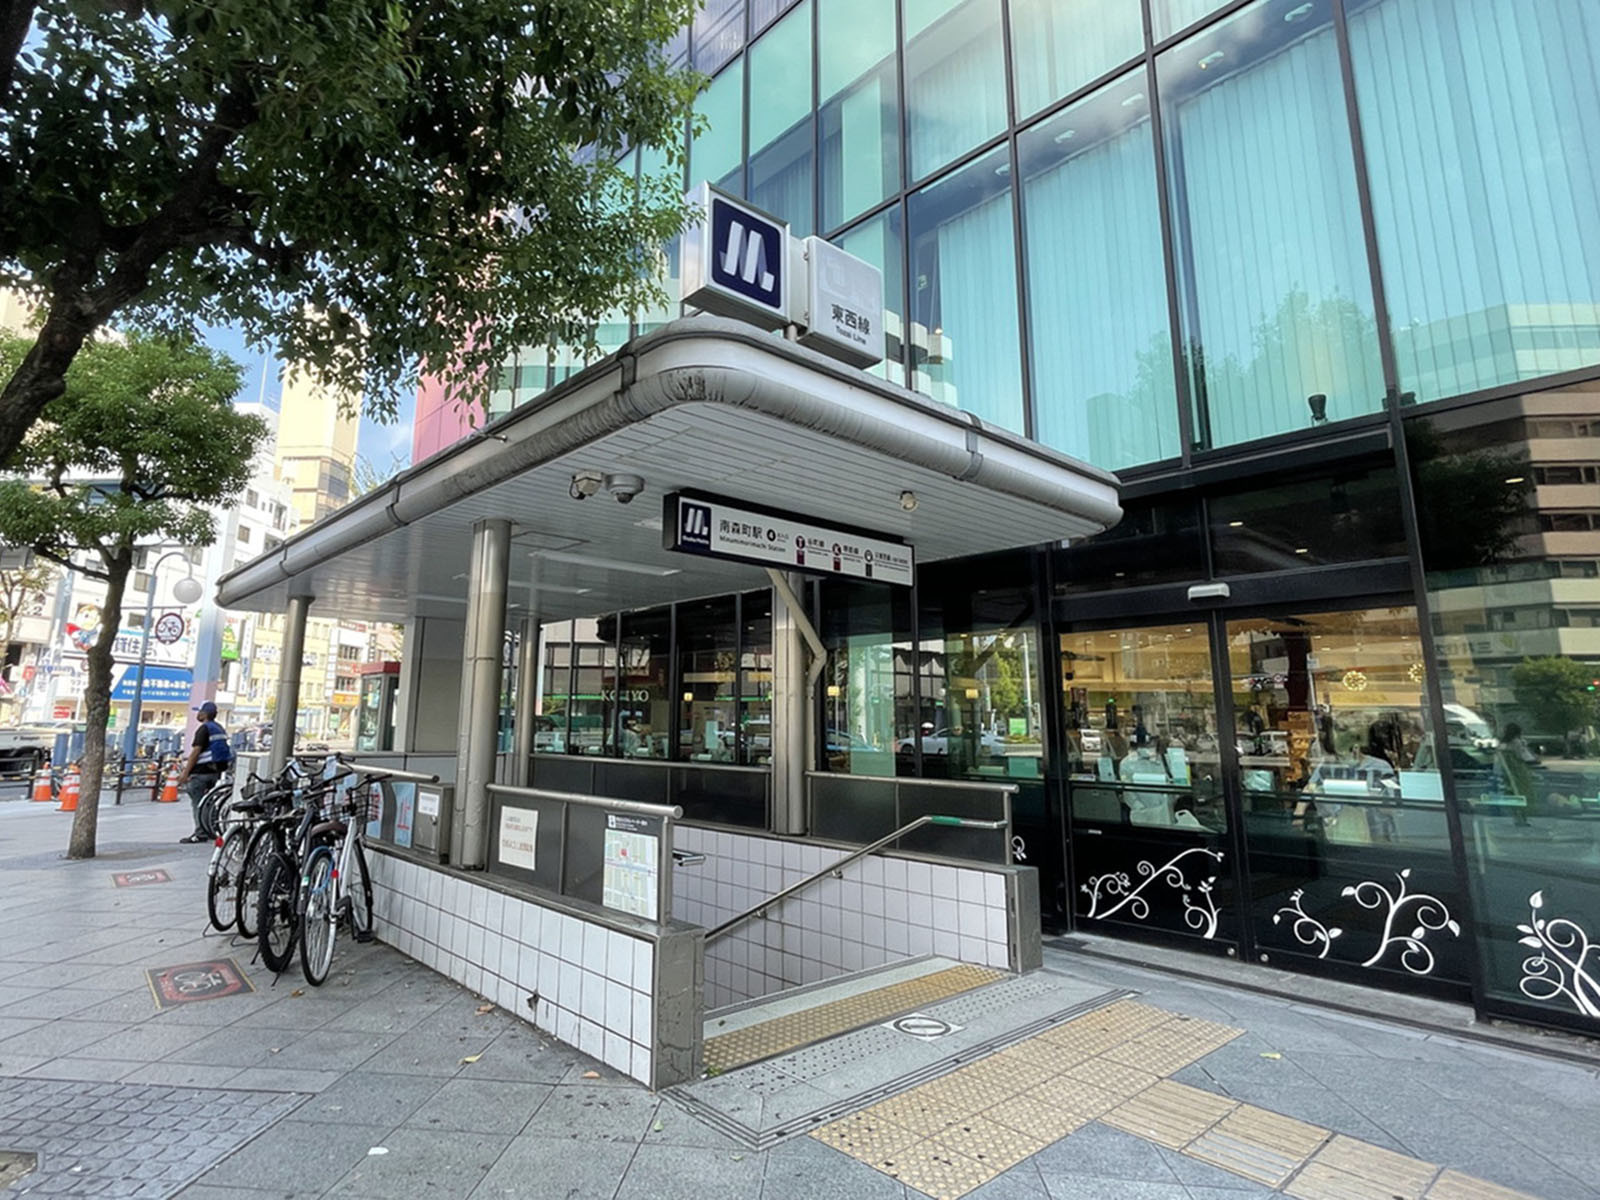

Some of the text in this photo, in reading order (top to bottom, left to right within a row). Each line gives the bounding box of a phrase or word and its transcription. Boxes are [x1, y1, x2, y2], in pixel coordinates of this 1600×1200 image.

[831, 304, 870, 336] 東西線
[719, 519, 763, 539] 南森町駅
